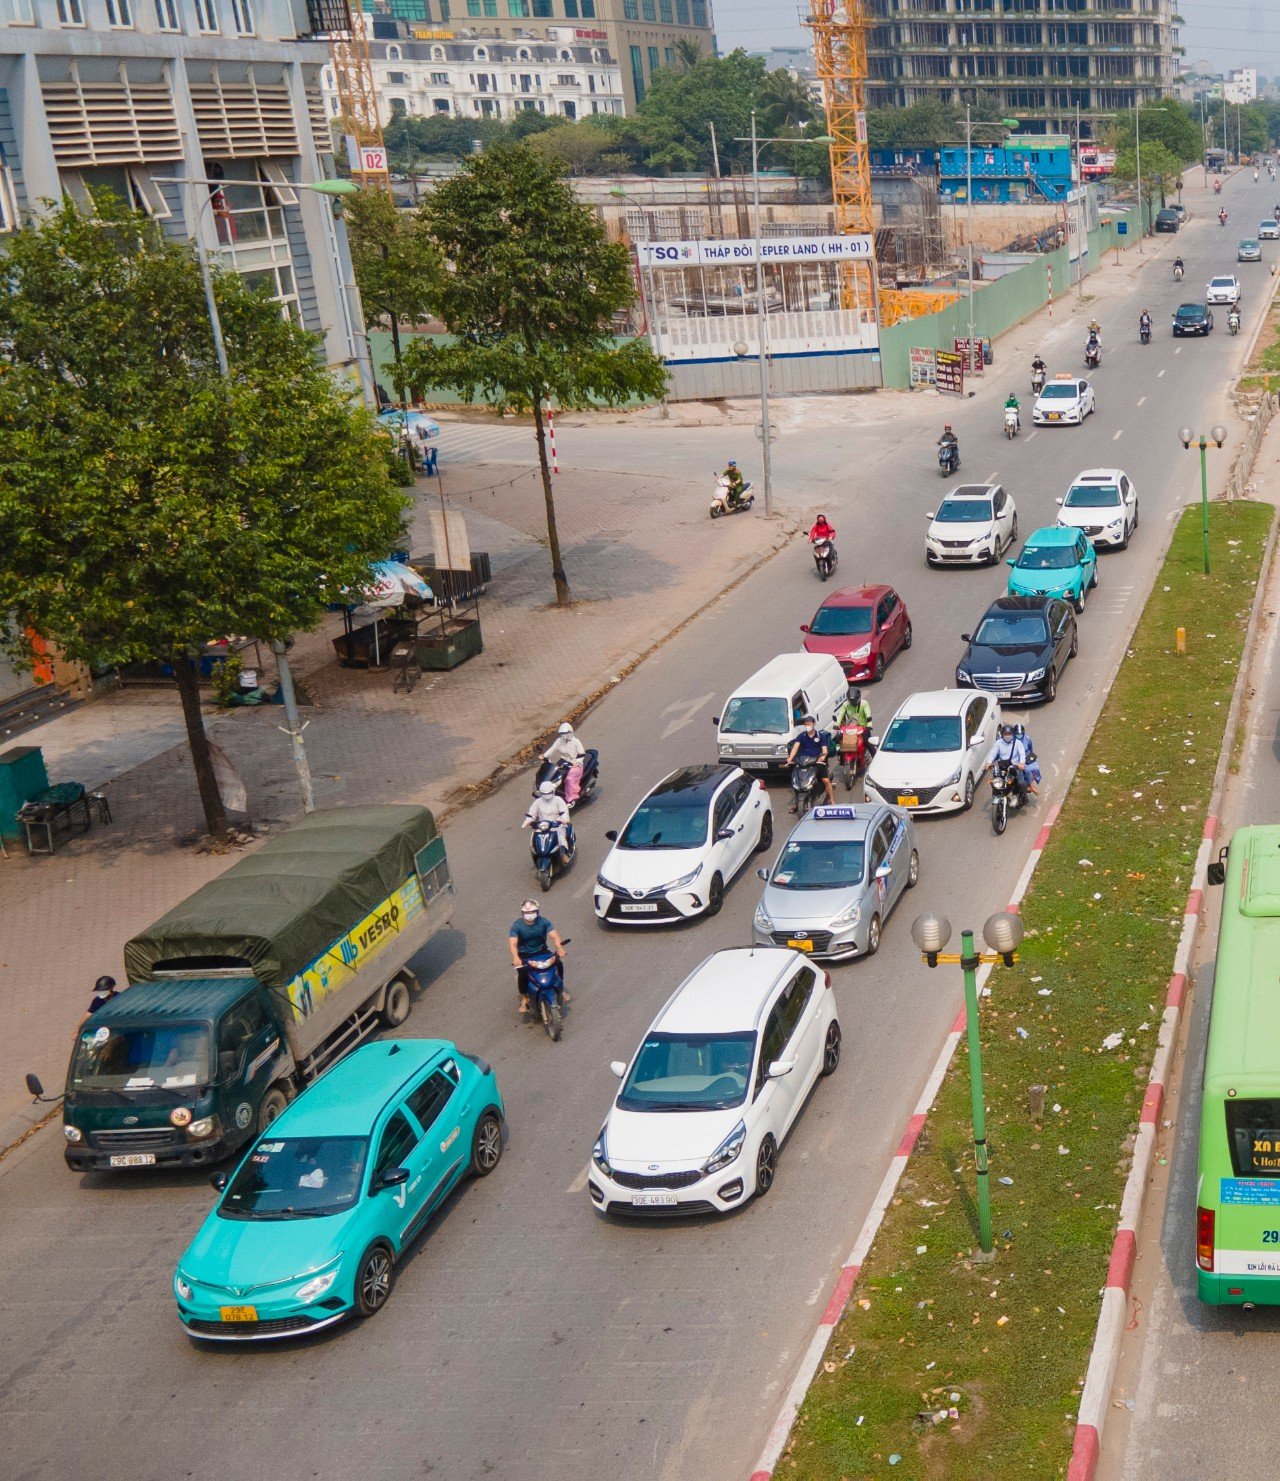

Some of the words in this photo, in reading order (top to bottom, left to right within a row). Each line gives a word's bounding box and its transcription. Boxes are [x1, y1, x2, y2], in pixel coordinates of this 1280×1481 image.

[366, 153, 383, 169] 02
[643, 246, 679, 260] TSQ
[704, 243, 730, 258] THÁP
[759, 244, 789, 256] EPLER
[793, 243, 818, 254] LAND
[358, 905, 399, 950] VESBO
